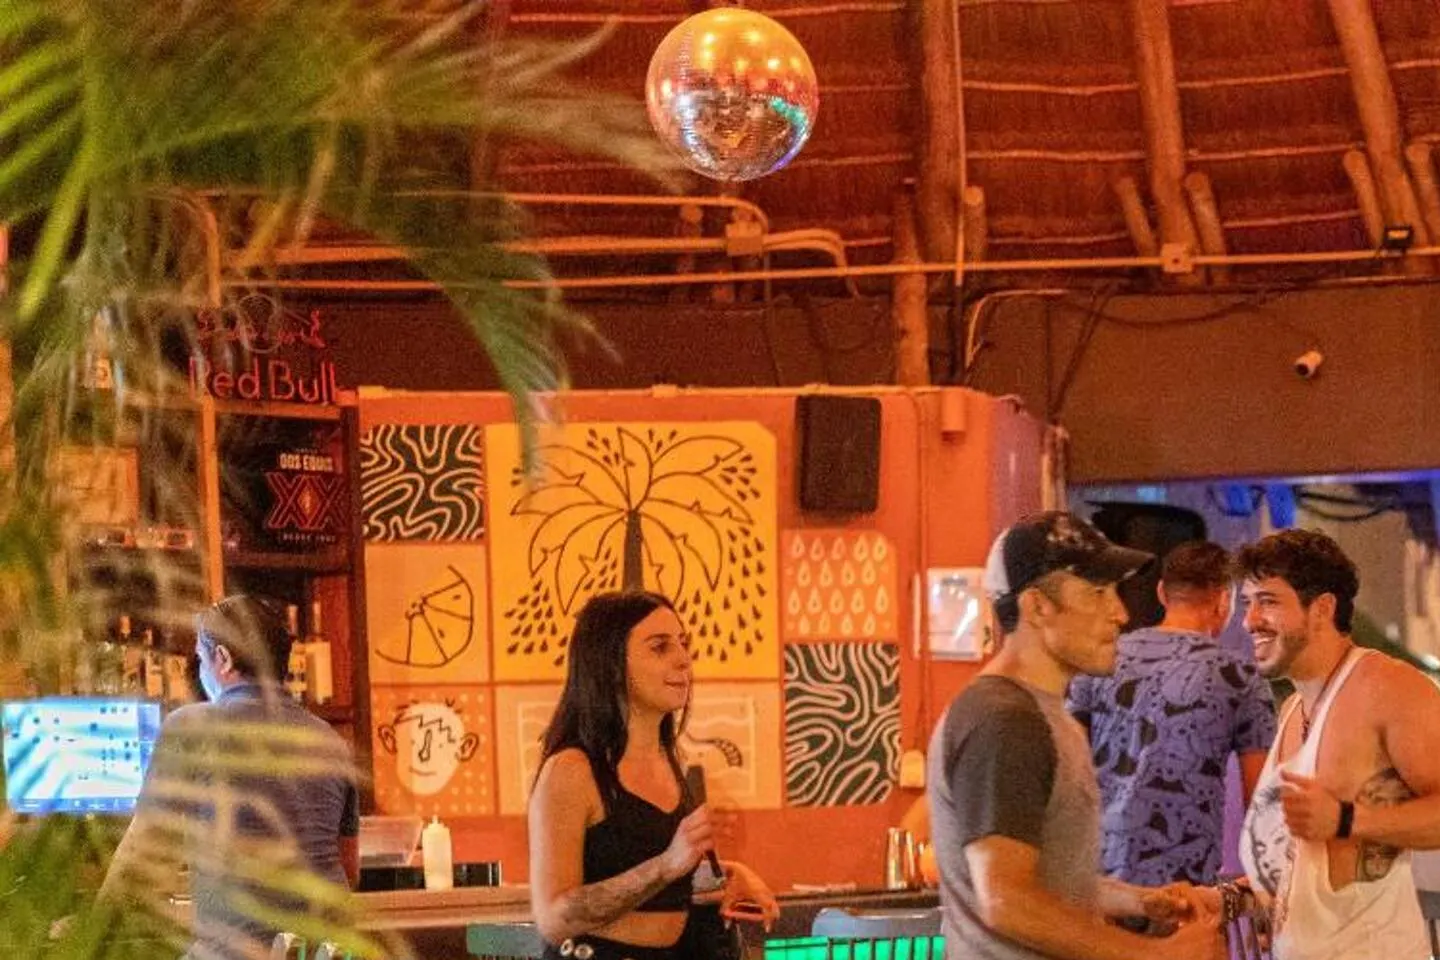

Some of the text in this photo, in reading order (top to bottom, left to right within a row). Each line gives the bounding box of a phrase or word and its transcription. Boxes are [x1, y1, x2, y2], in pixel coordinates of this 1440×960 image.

[189, 356, 337, 405] Red Bull
[265, 471, 346, 530] XX
